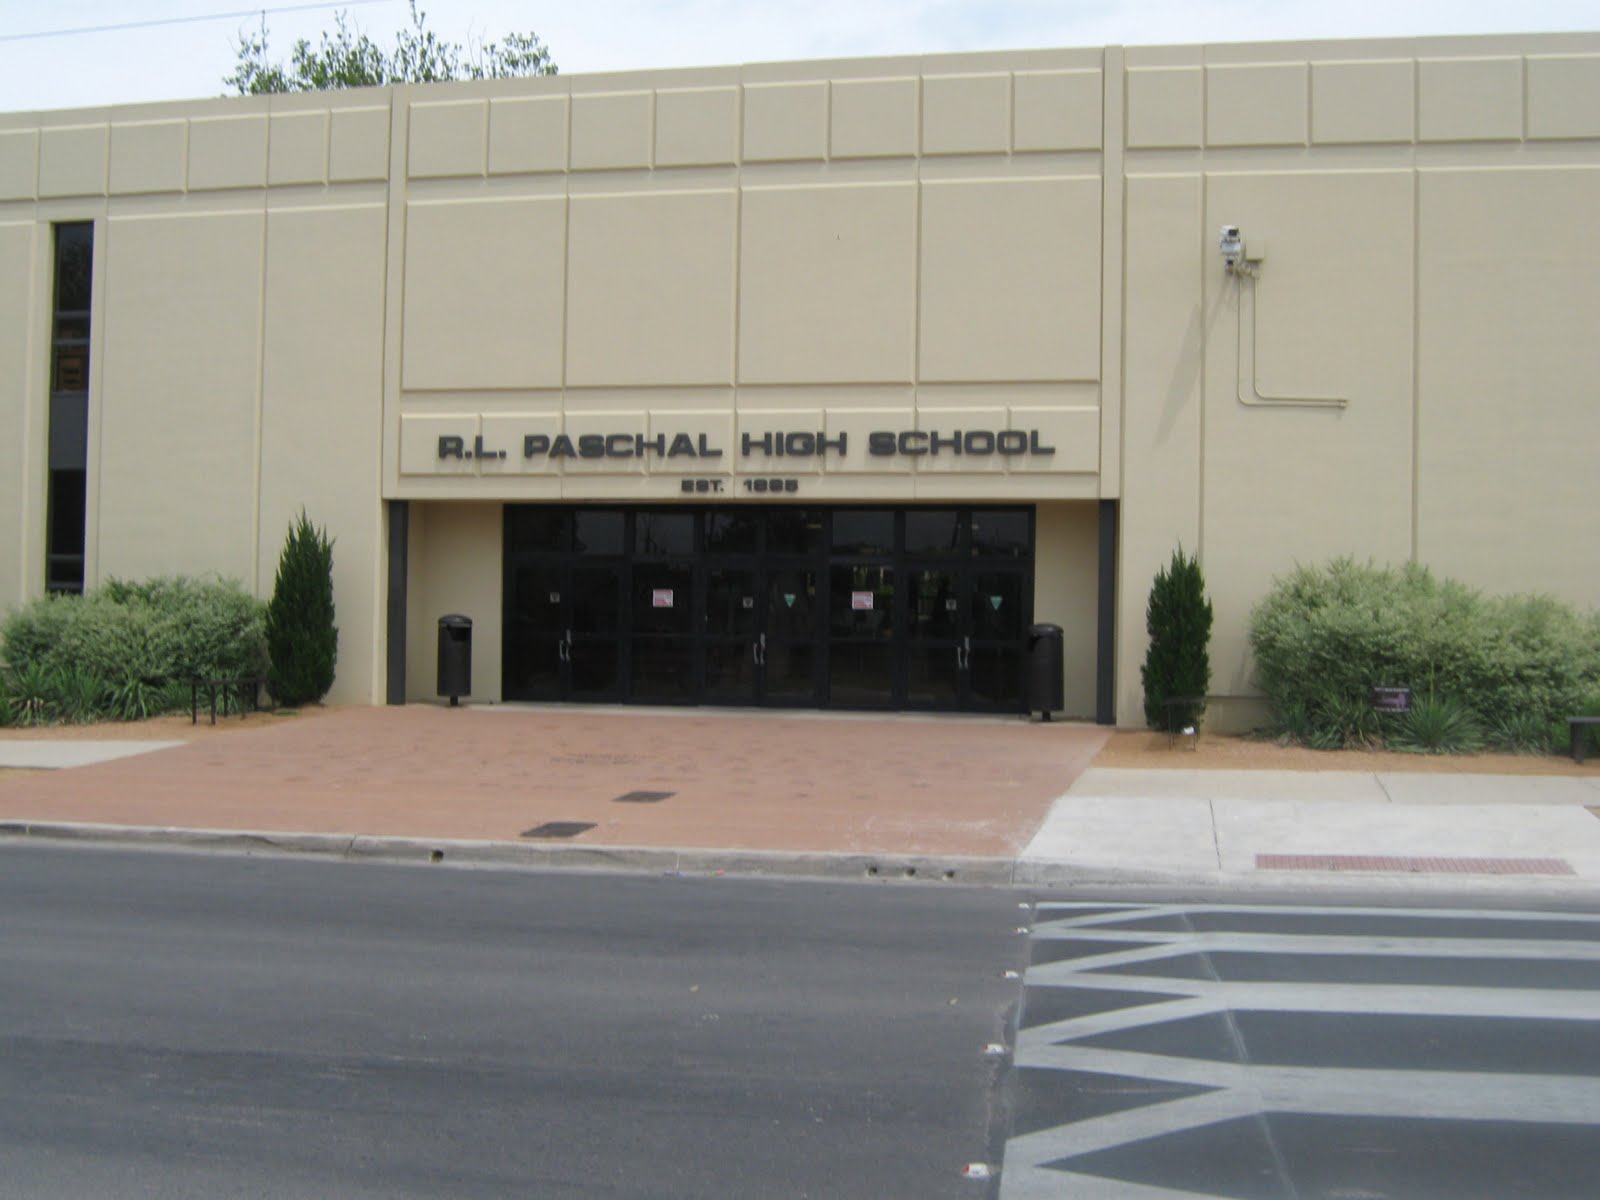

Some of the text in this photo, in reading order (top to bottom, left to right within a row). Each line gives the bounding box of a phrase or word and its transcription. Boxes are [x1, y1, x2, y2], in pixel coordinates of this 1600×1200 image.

[438, 429, 1056, 460] R.L. PASCHAL HIGH SCHOOL
[681, 479, 724, 493] EST.
